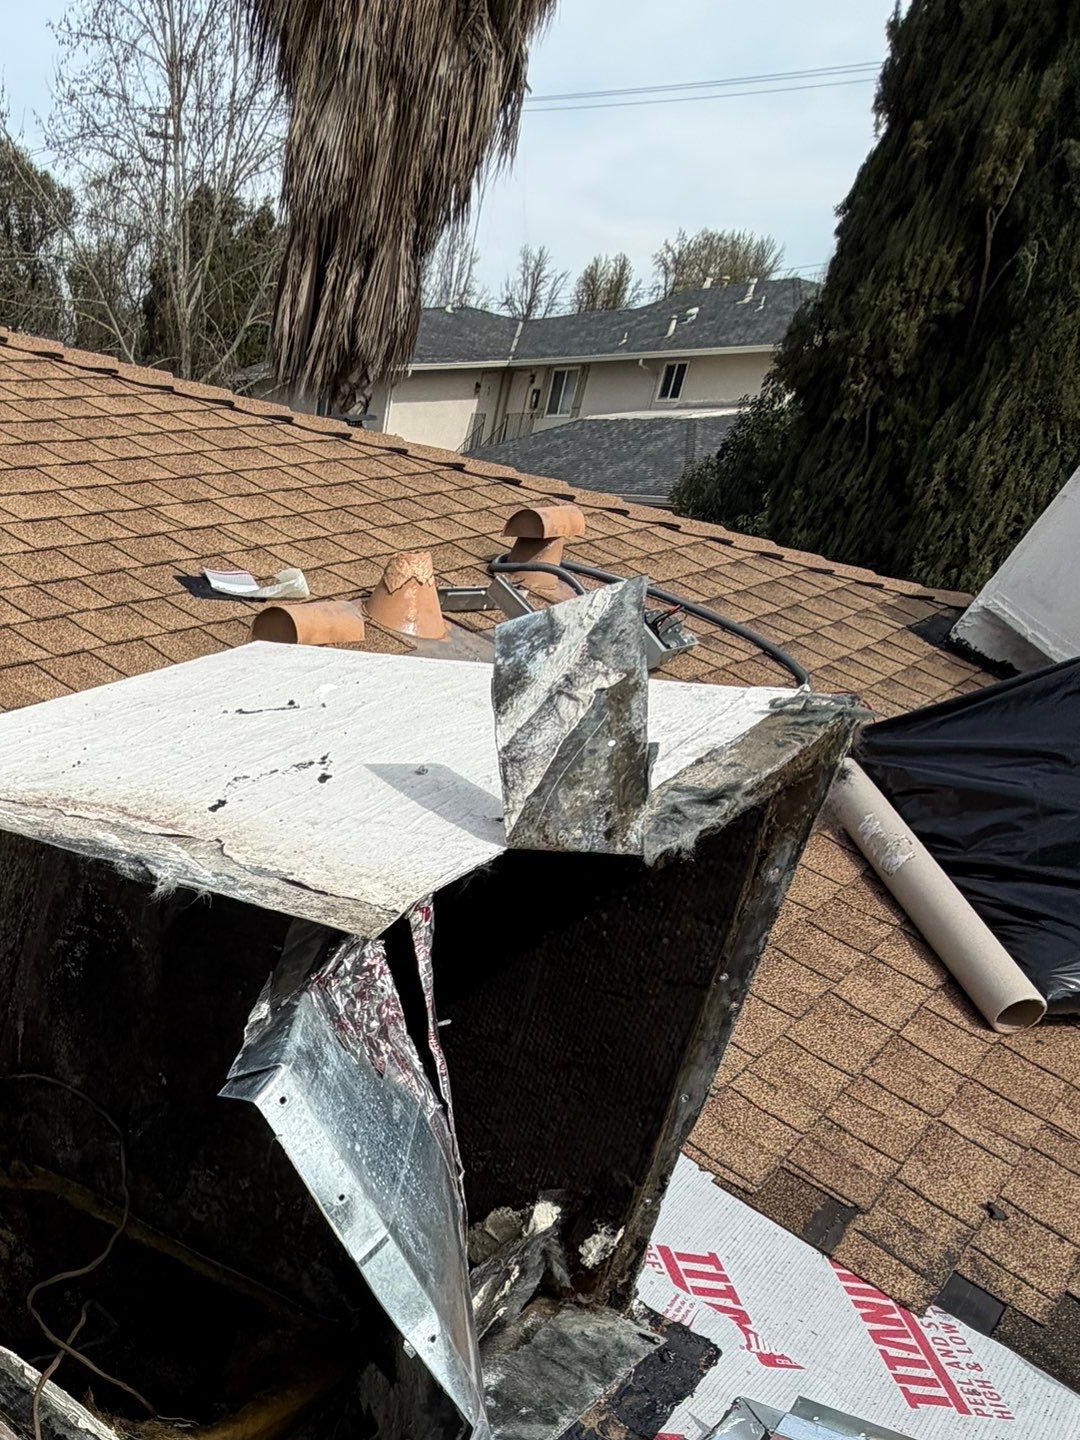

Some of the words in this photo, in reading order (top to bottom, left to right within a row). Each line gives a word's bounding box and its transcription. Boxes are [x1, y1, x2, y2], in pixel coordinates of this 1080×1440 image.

[931, 1336, 964, 1371] AND
[941, 1322, 975, 1356] LOW
[966, 1361, 984, 1373] &
[976, 1379, 1016, 1421] HIGH
